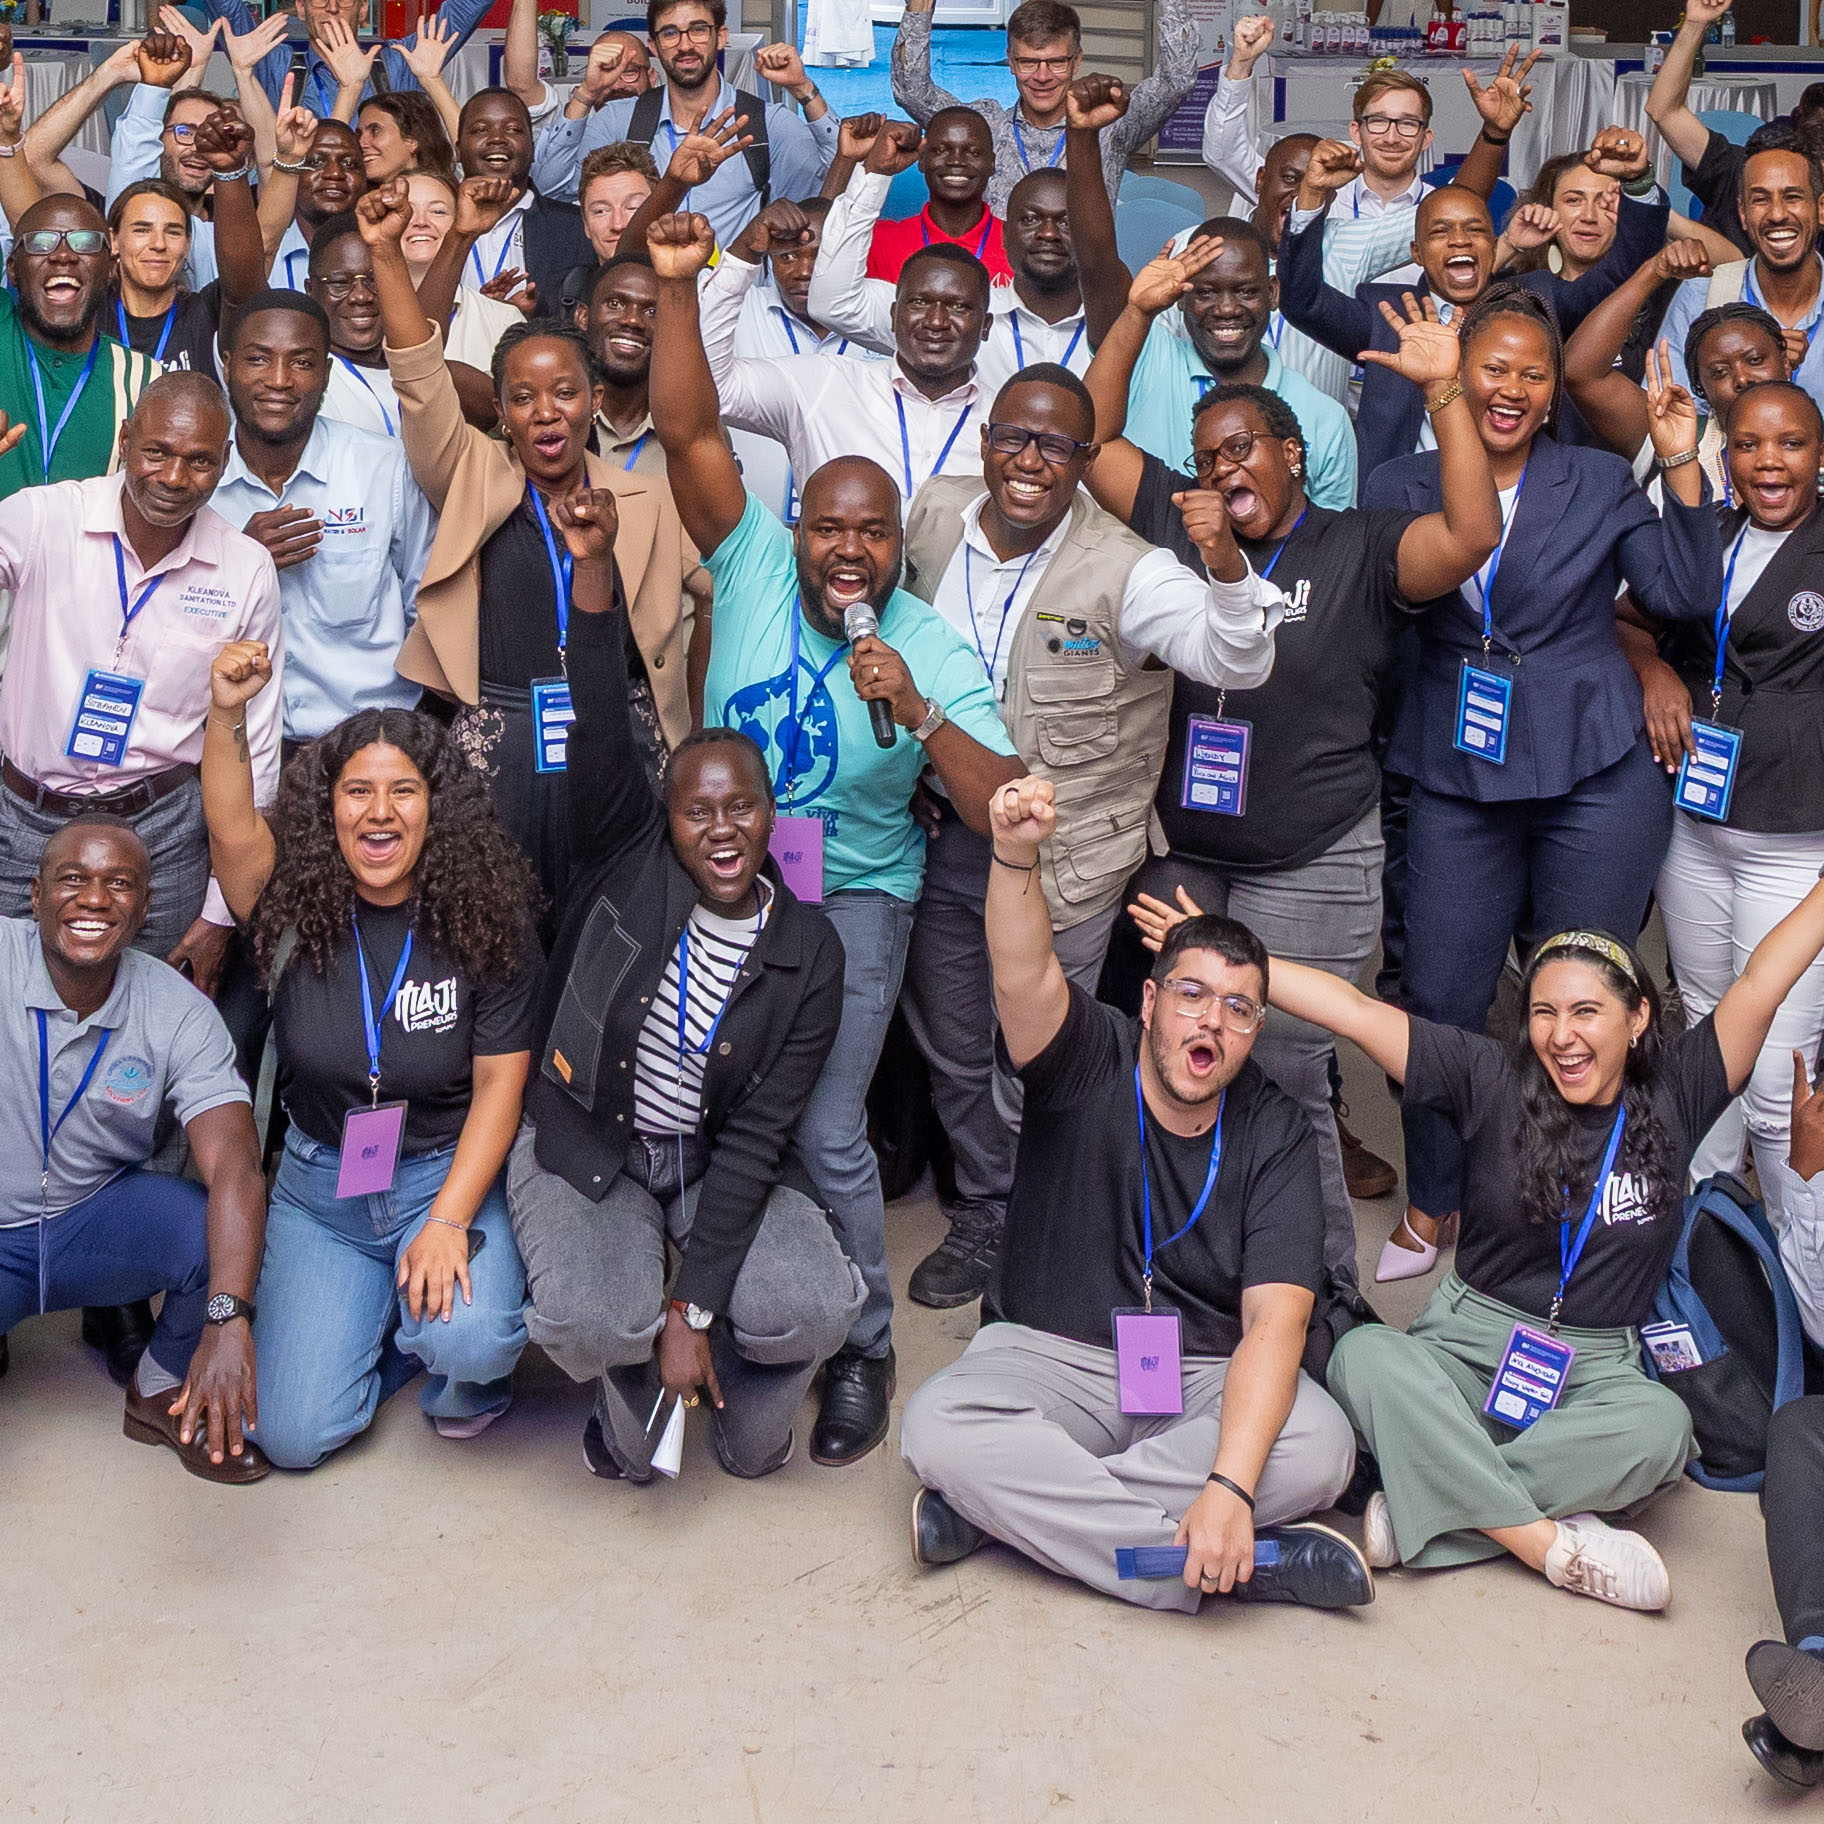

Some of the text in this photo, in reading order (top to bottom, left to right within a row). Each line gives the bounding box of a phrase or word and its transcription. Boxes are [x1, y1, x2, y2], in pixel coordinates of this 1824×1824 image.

[187, 586, 230, 599] KLEANOVA
[183, 606, 228, 619] EXECUTIVE
[1063, 649, 1099, 657] GIANTS
[85, 697, 128, 715] STEPHEN
[805, 808, 840, 821] viva
[411, 1012, 458, 1031] PRENEURS
